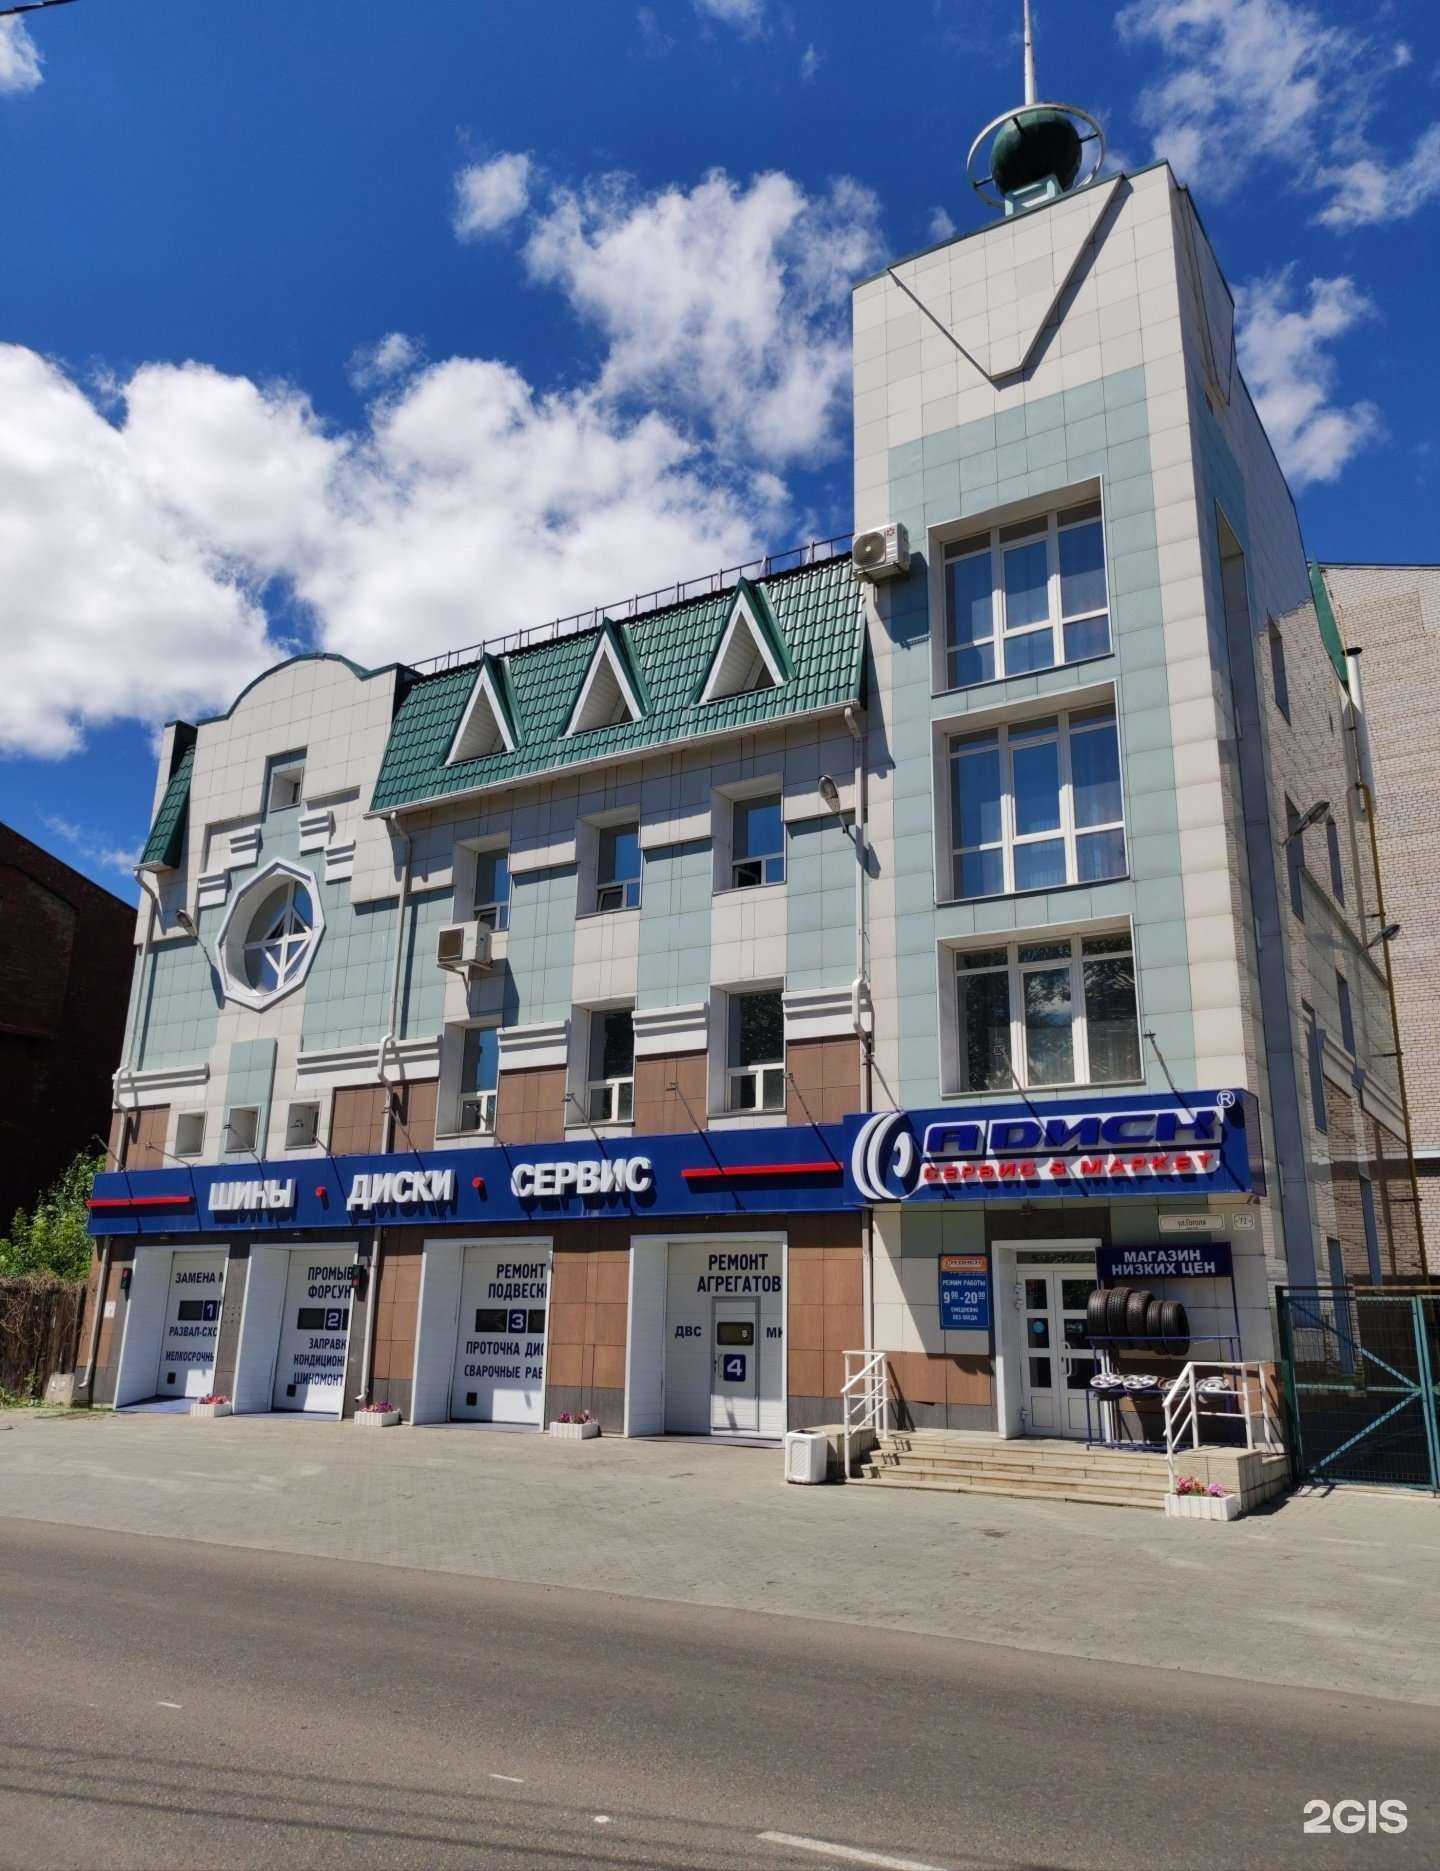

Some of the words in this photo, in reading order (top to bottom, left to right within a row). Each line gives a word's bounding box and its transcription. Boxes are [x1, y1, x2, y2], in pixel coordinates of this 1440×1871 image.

[924, 1161, 1037, 1181] СЕРВИС
[1049, 1161, 1067, 1177] &
[1081, 1152, 1214, 1176] МАРКЕТ
[208, 1178, 295, 1211] ШИНЫ
[346, 1169, 456, 1211] ДИСКИ
[511, 1156, 652, 1198] СЕРВИС
[708, 1254, 768, 1271] РЕМОНТ
[1123, 1250, 1201, 1263] МАГАЗИН
[308, 1266, 353, 1280] ПРОМЫВ
[496, 1264, 546, 1279] РЕМОНТ
[1111, 1263, 1177, 1276] НИЗКИХ
[1181, 1262, 1216, 1276] ЦЕН
[175, 1272, 215, 1284] ЗАМЕНА
[697, 1276, 782, 1292] АГРЕГАТОВ
[206, 1303, 214, 1318] 1
[328, 1312, 339, 1327] 2
[511, 1313, 524, 1329] 3
[674, 1326, 702, 1339] ДВС
[466, 1341, 520, 1355] ПРОТОЧКА
[464, 1364, 520, 1379] СВАРОЧНЫЕ
[726, 1359, 742, 1376] 4
[294, 1372, 344, 1385] ШИНОМОНТ
